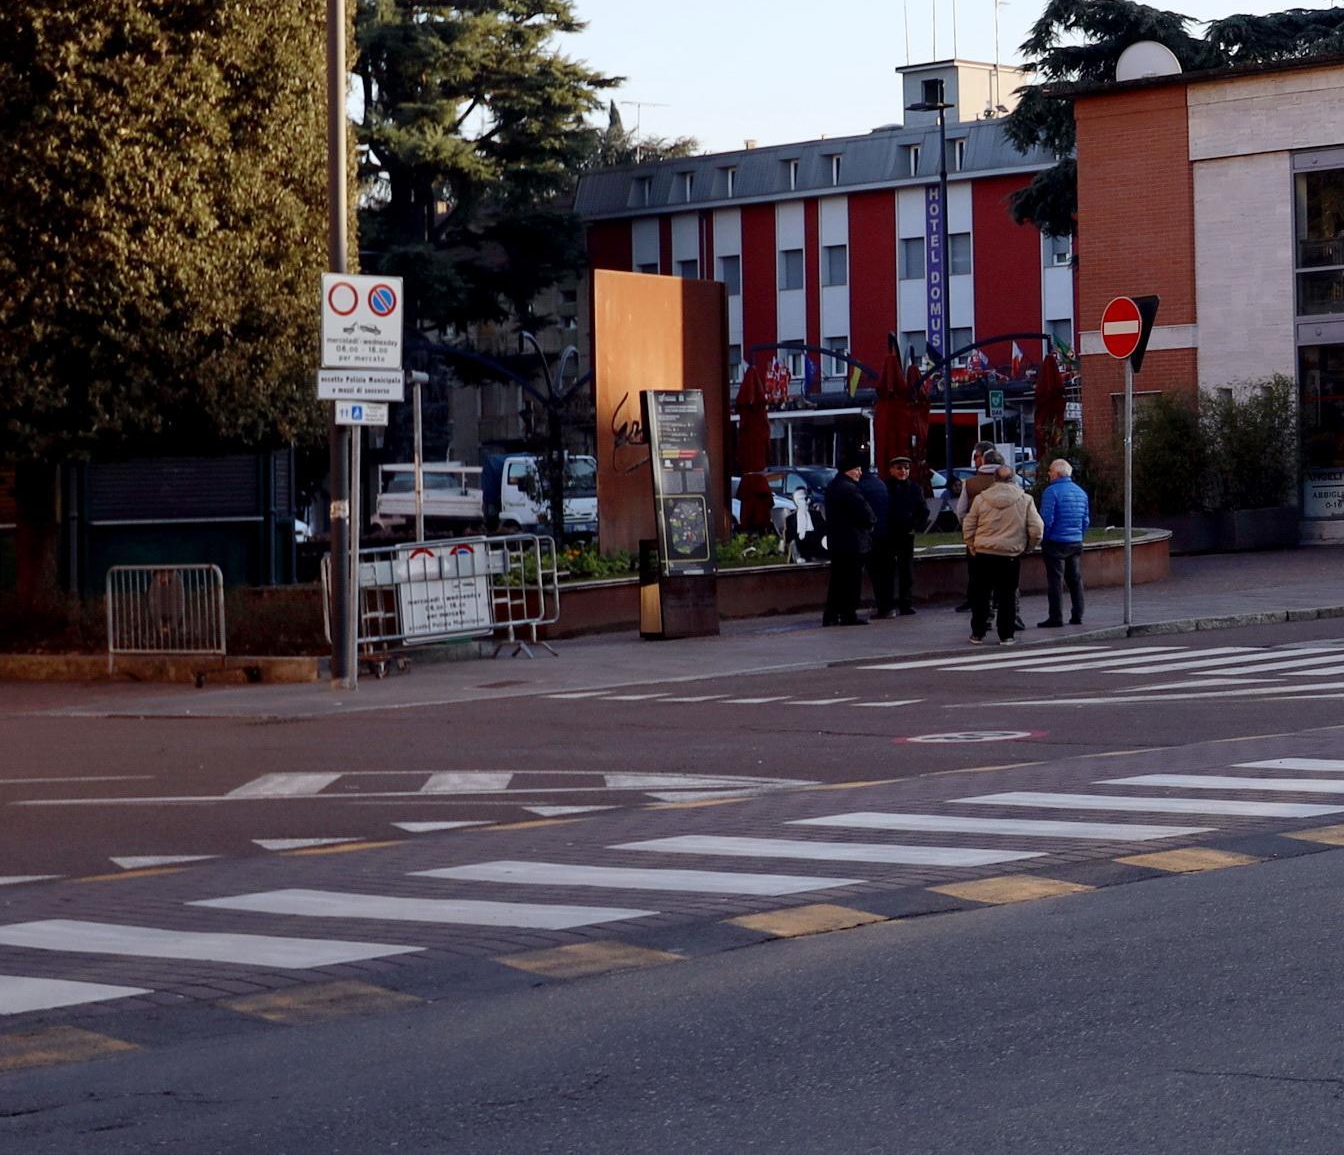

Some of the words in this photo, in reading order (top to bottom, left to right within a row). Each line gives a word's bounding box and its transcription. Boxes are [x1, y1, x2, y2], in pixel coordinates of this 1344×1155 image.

[928, 188, 940, 263] HOTEL
[930, 272, 942, 347] DOMUS
[368, 376, 401, 384] Municipale
